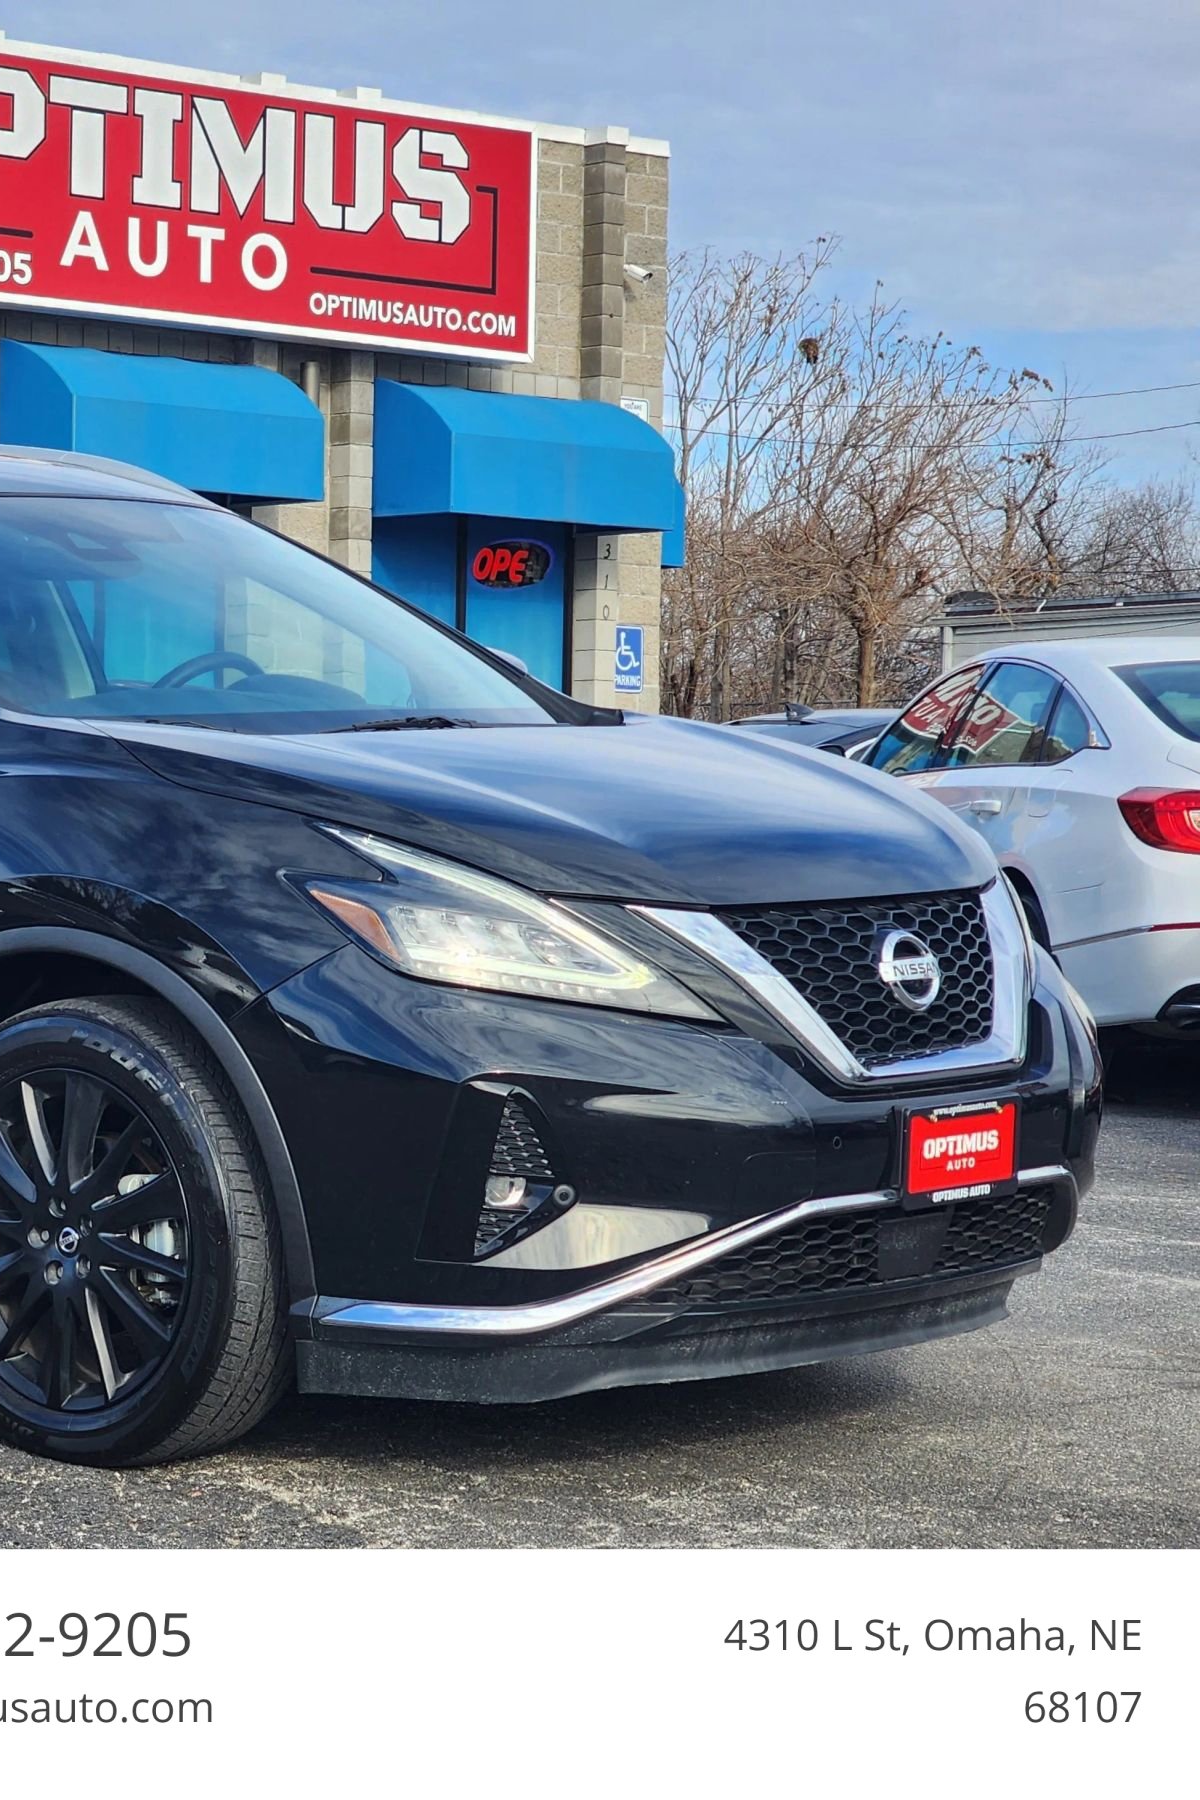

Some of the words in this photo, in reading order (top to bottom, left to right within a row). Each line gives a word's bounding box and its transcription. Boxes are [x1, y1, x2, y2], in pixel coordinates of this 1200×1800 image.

[60, 211, 288, 291] AUTO
[309, 292, 517, 338] OPTIMUSAUTO.COM
[473, 547, 538, 584] OPE
[615, 675, 641, 687] PARKING
[892, 961, 941, 977] NISSAN
[923, 1129, 999, 1160] OPTIMUS
[946, 1158, 976, 1171] AUTO
[932, 1187, 969, 1203] OPTIMUS
[969, 1184, 991, 1197] AUTO
